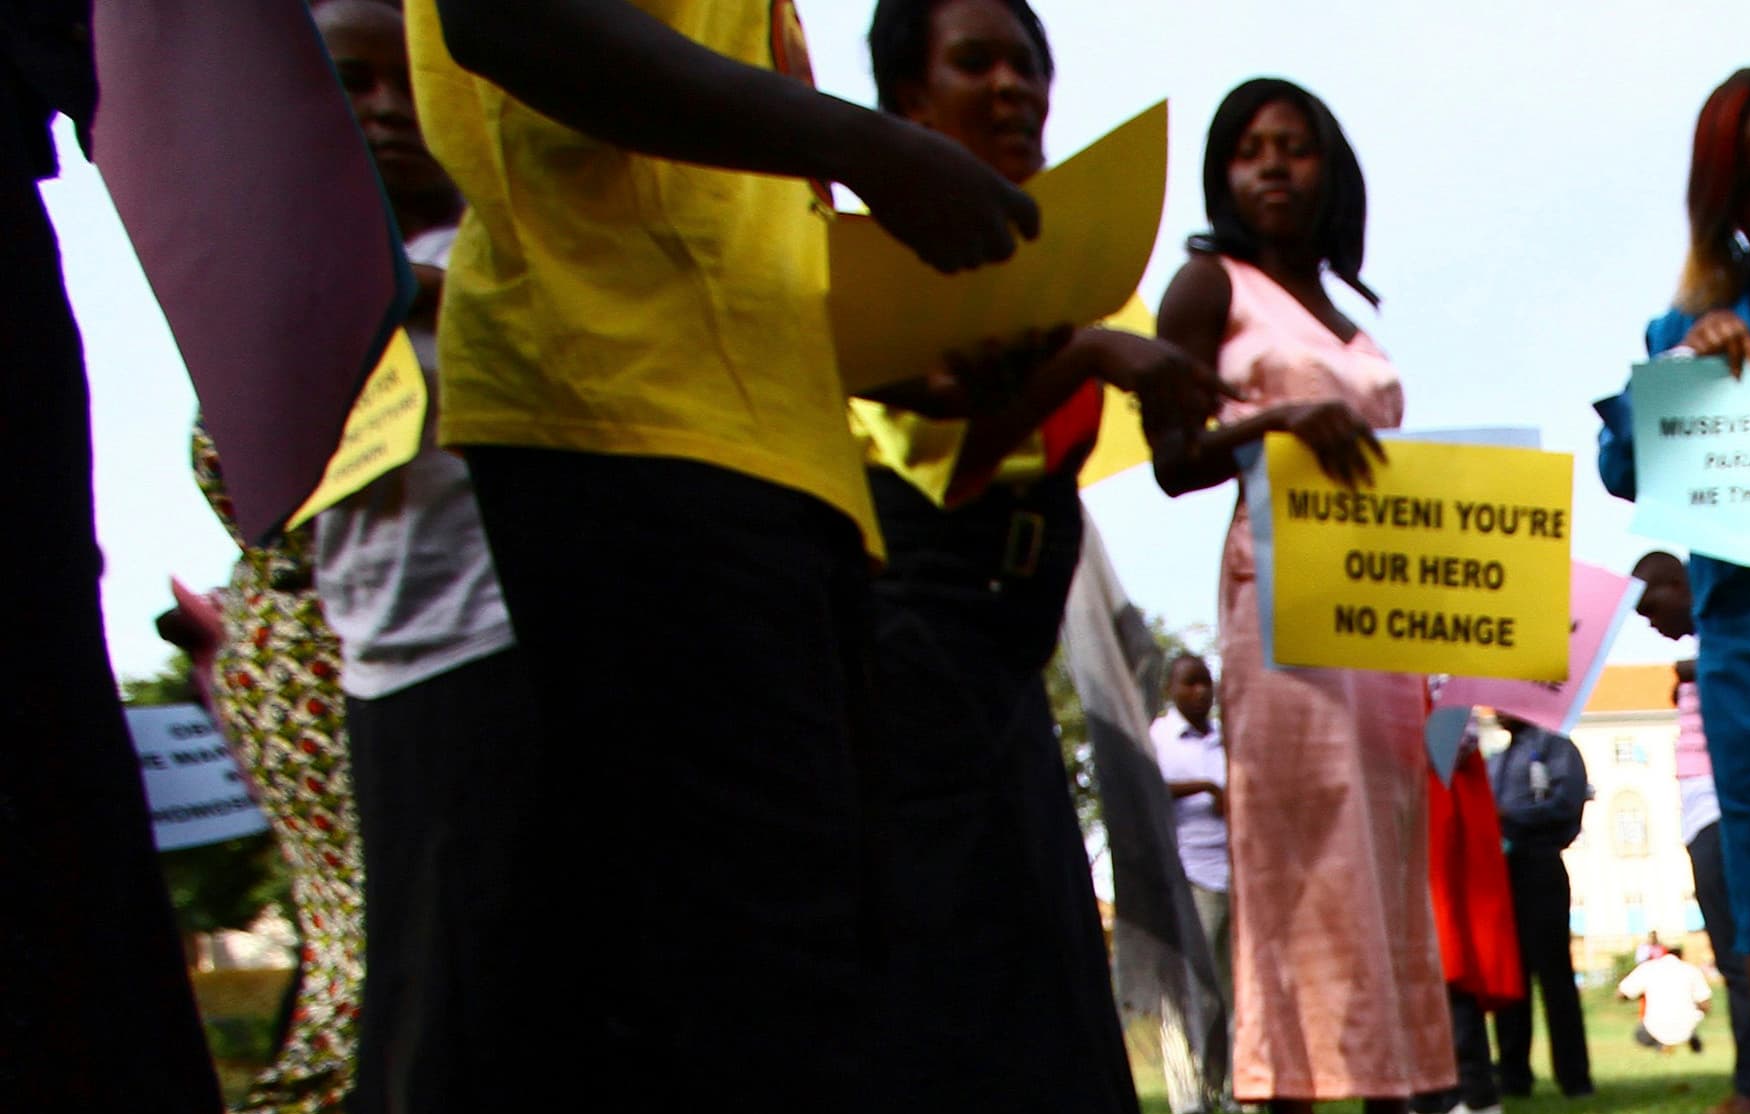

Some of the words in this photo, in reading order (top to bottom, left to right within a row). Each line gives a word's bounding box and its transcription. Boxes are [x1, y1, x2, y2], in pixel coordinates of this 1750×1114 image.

[1288, 489, 1443, 529] MUSEVENI
[1454, 500, 1566, 538] YOU'RE
[1345, 551, 1409, 583] OUR
[1419, 556, 1505, 590] HERO
[1334, 605, 1377, 636] NO
[1387, 611, 1515, 647] CHANGE
